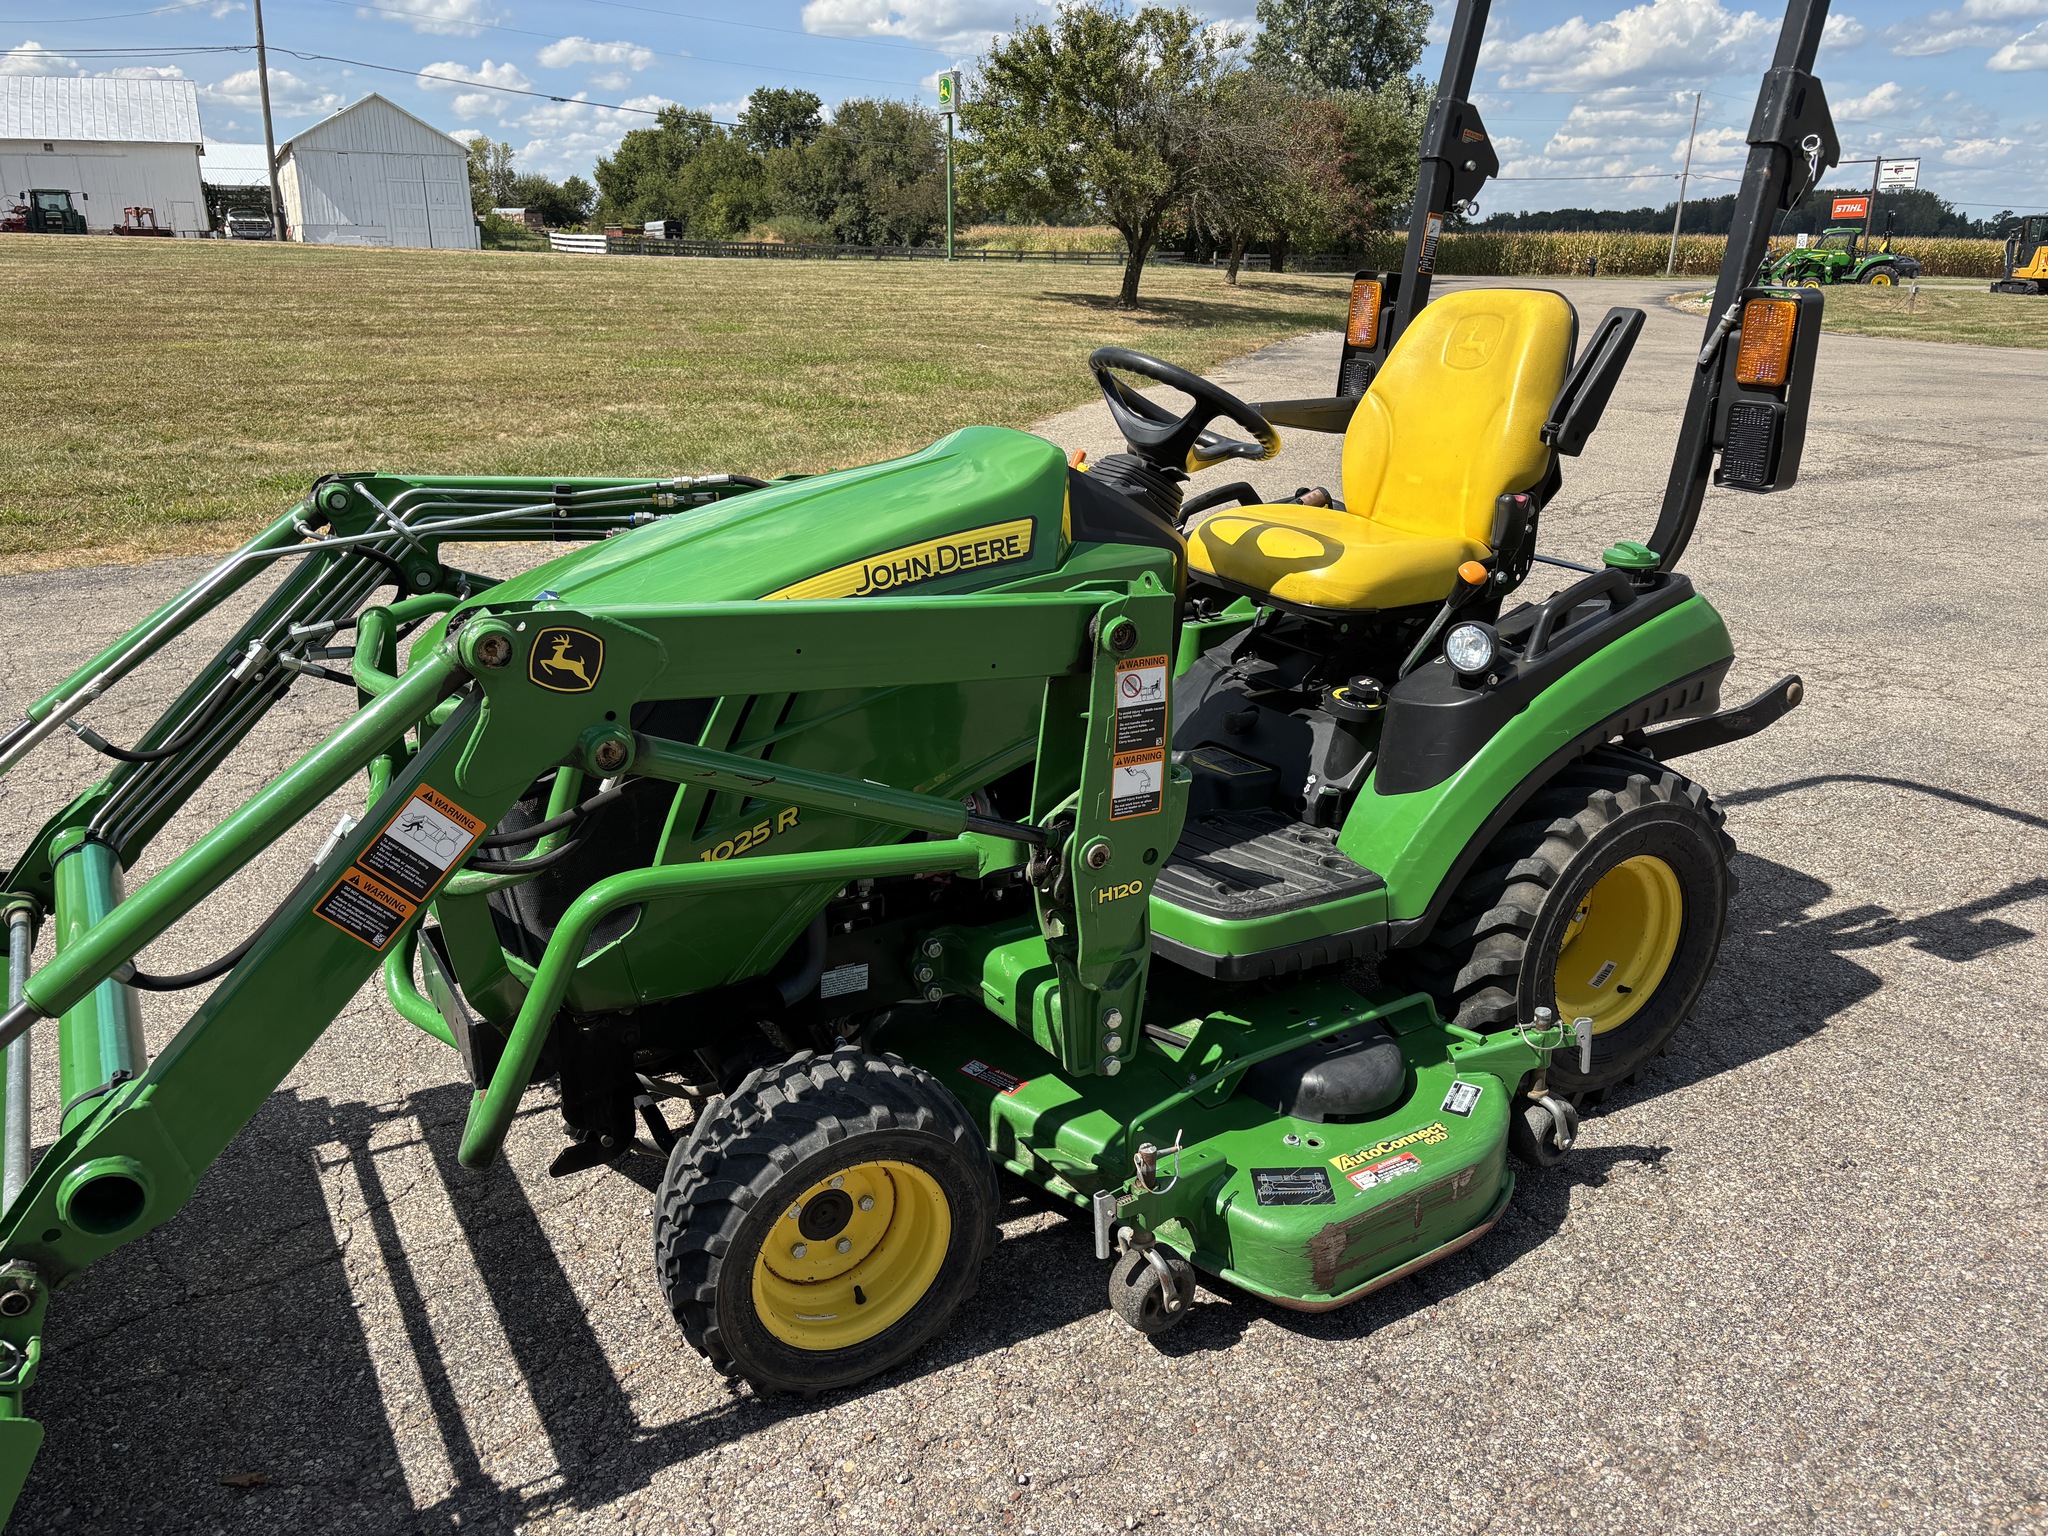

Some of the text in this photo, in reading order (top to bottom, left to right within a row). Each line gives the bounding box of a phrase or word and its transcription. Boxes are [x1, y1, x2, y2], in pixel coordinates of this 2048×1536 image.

[1835, 204, 1863, 213] STIHL
[856, 535, 1021, 593] JOHN DEERE
[1125, 656, 1165, 668] WARNING
[1123, 751, 1162, 764] WARNING
[434, 797, 477, 830] WARNING
[700, 806, 800, 863] 1025 R
[363, 881, 407, 913] WARNING
[1098, 880, 1143, 904] H120
[1339, 1121, 1449, 1170] AutoConnect
